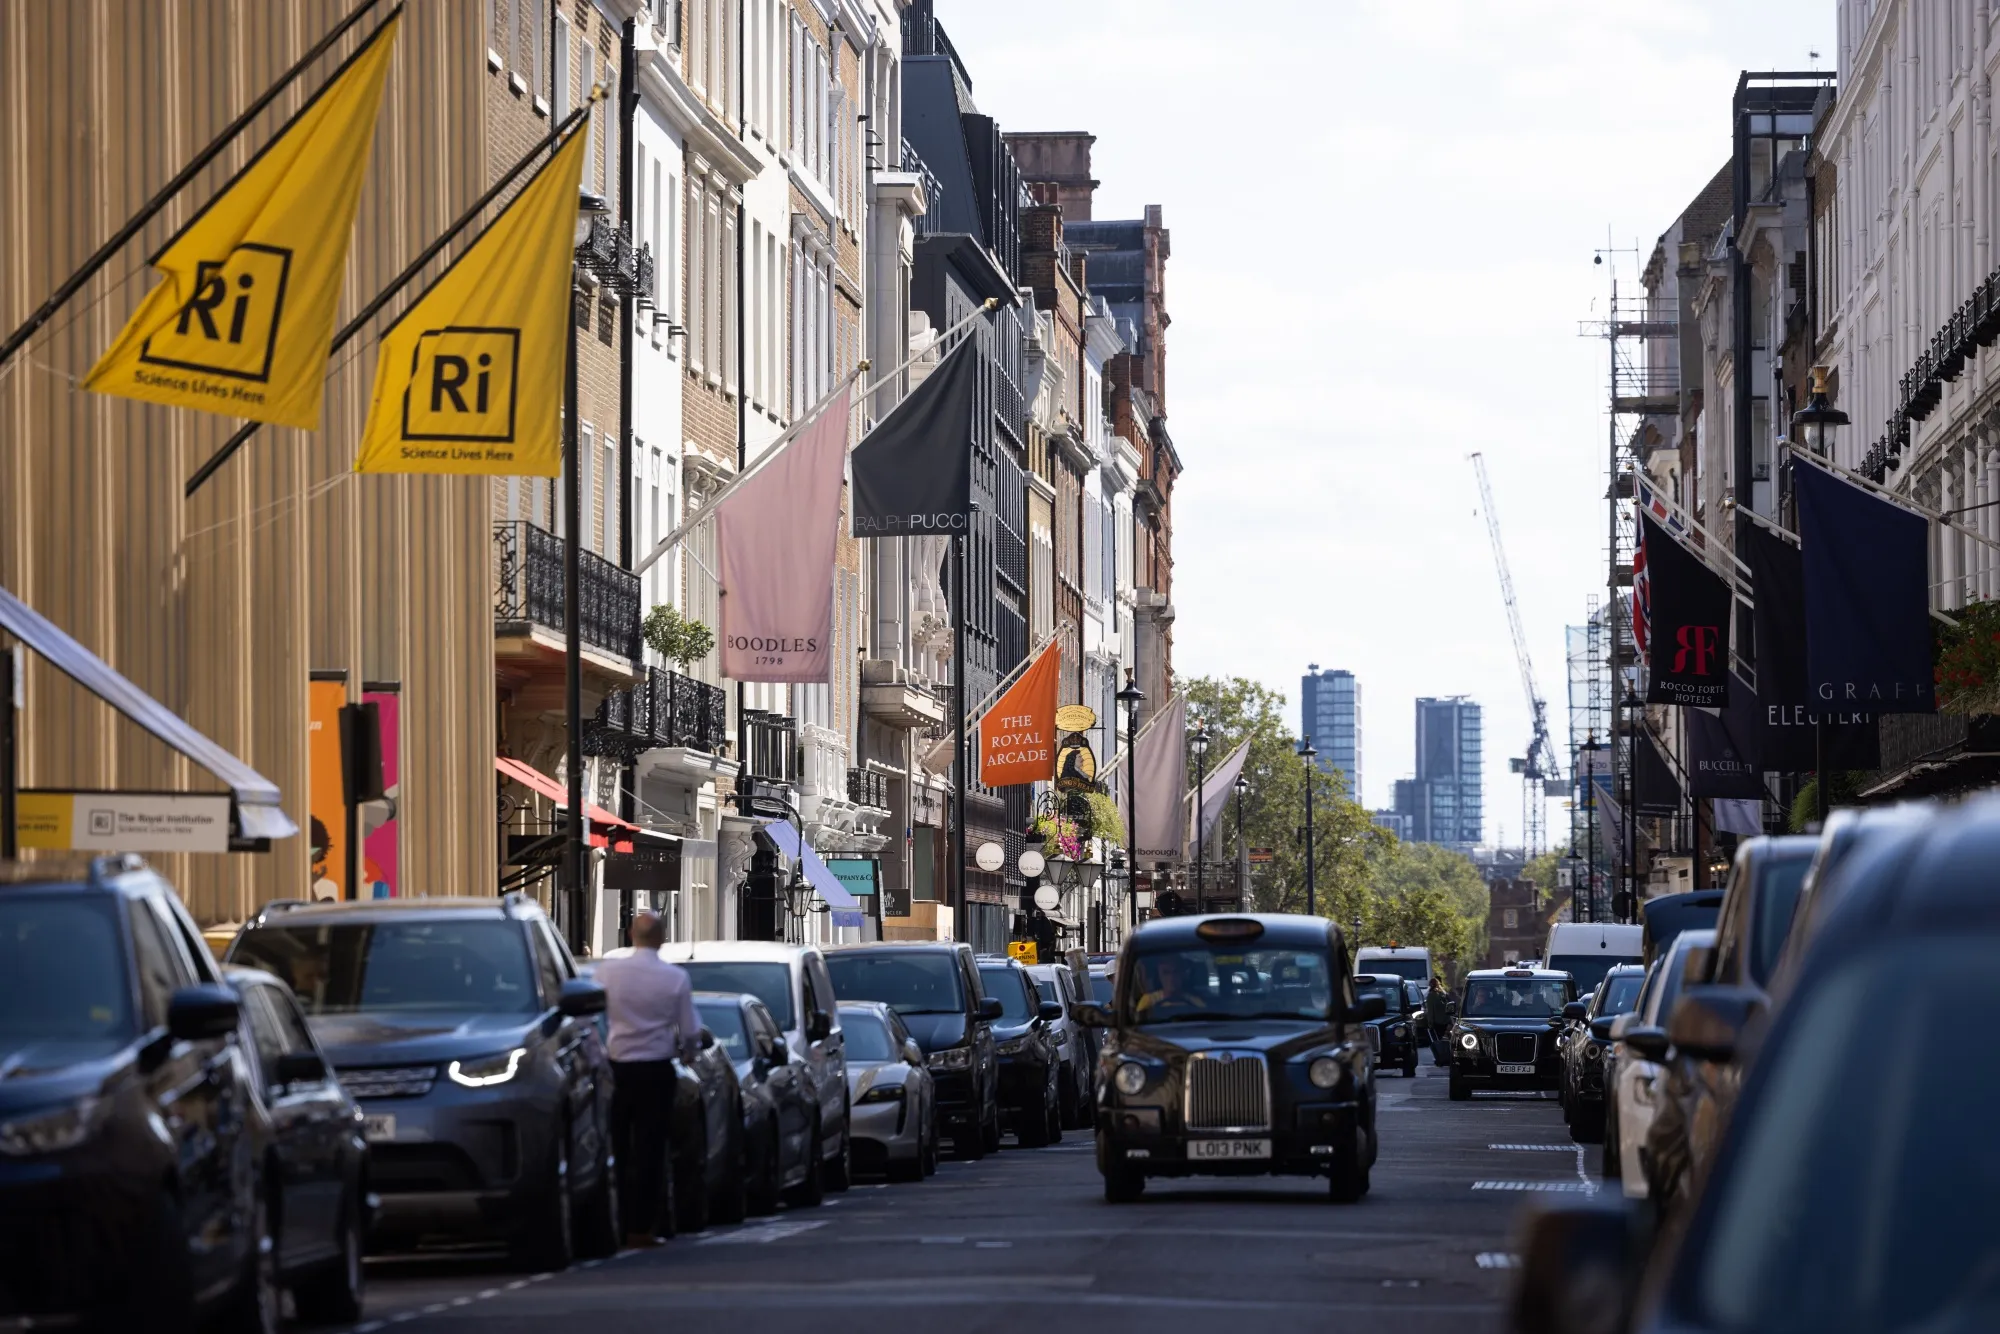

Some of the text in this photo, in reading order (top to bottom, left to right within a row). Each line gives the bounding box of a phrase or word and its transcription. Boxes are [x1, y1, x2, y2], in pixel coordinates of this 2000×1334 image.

[176, 273, 254, 344] Ri
[135, 370, 265, 404] Science Lives Here
[431, 353, 492, 414] Ri
[401, 448, 514, 460] Science Lives Here
[727, 635, 817, 653] BOODLES
[755, 656, 783, 665] 1798
[1660, 681, 1725, 694] ROCCO FORTE
[1675, 694, 1712, 704] HOTELS
[1001, 715, 1032, 728] THE
[991, 732, 1043, 748] ROYAL
[986, 749, 1048, 767] ARCADE
[1125, 848, 1178, 857] lborough
[1232, 1142, 1262, 1157] PNK
